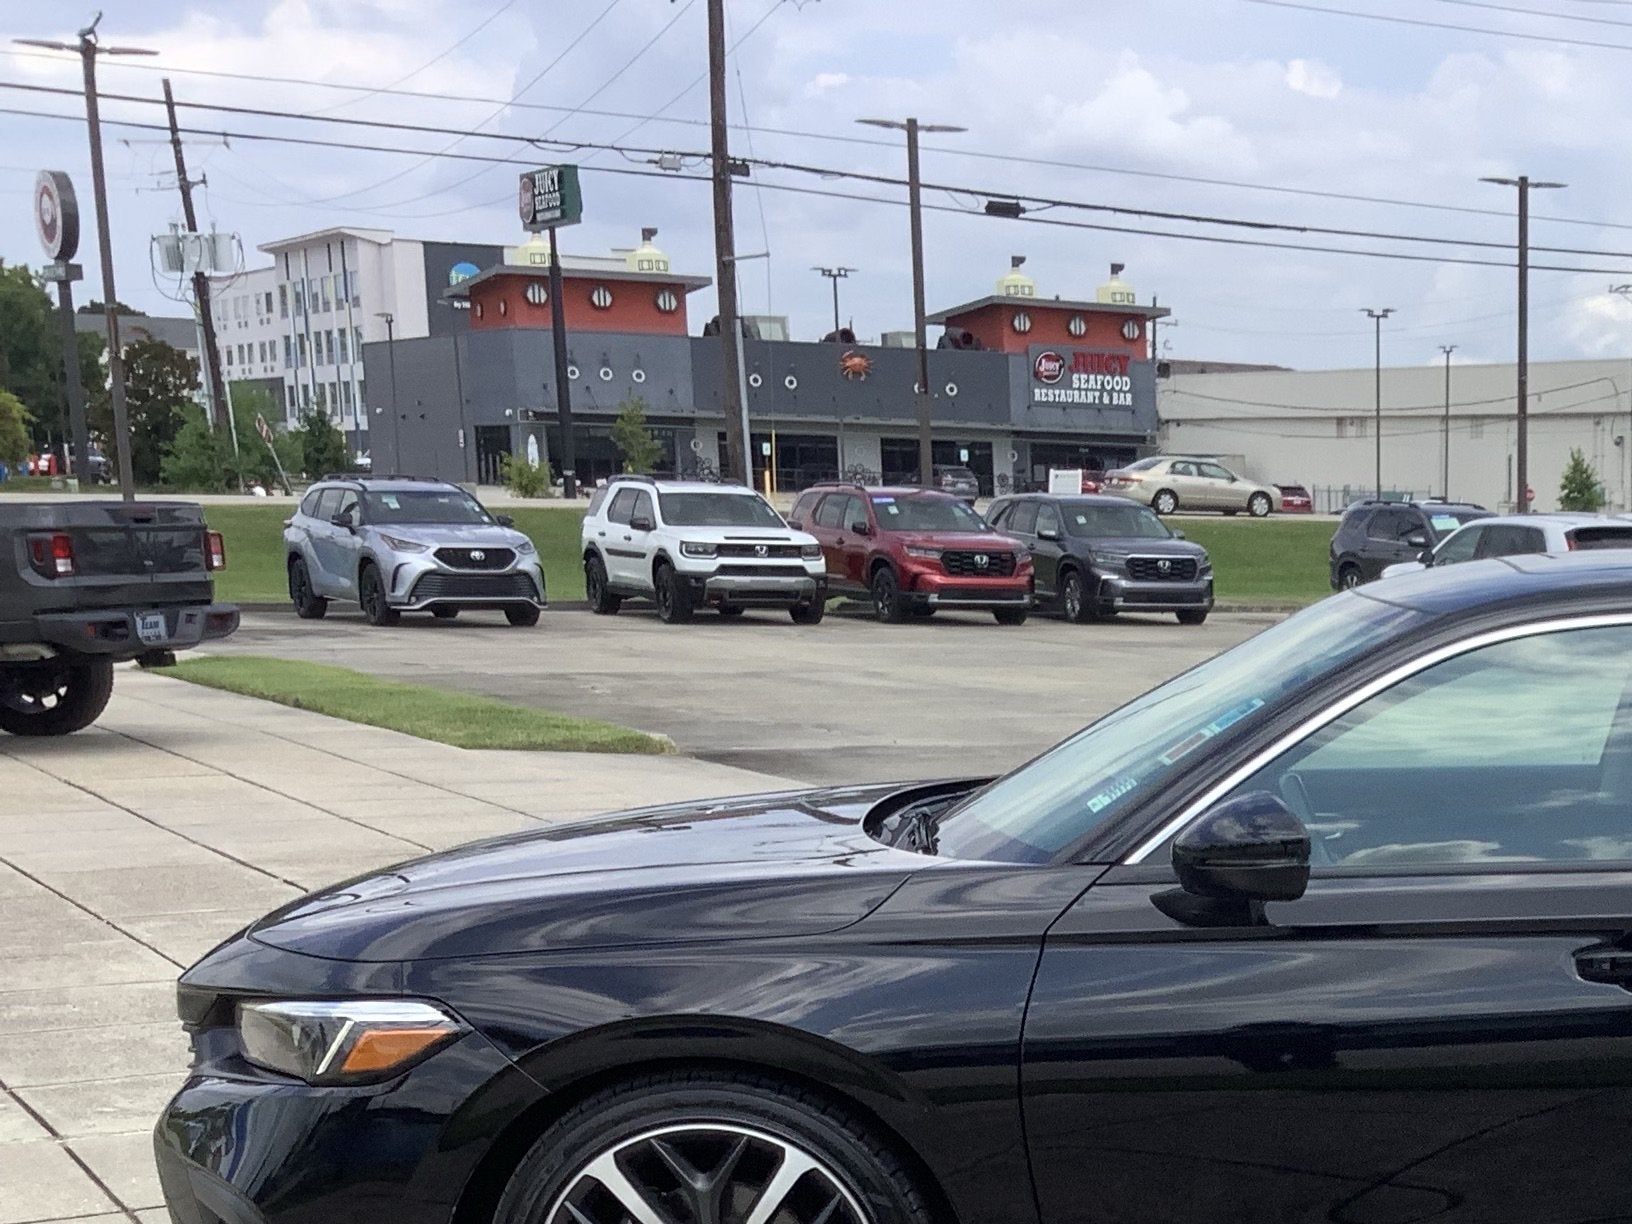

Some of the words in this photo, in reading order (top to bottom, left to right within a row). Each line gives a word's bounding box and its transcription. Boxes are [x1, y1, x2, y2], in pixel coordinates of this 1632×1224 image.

[534, 167, 559, 195] JUICY
[1072, 373, 1131, 391] SEAFOOD
[1034, 388, 1100, 404] RESTAURANT
[1102, 391, 1110, 405] &
[1112, 392, 1132, 405] BAR
